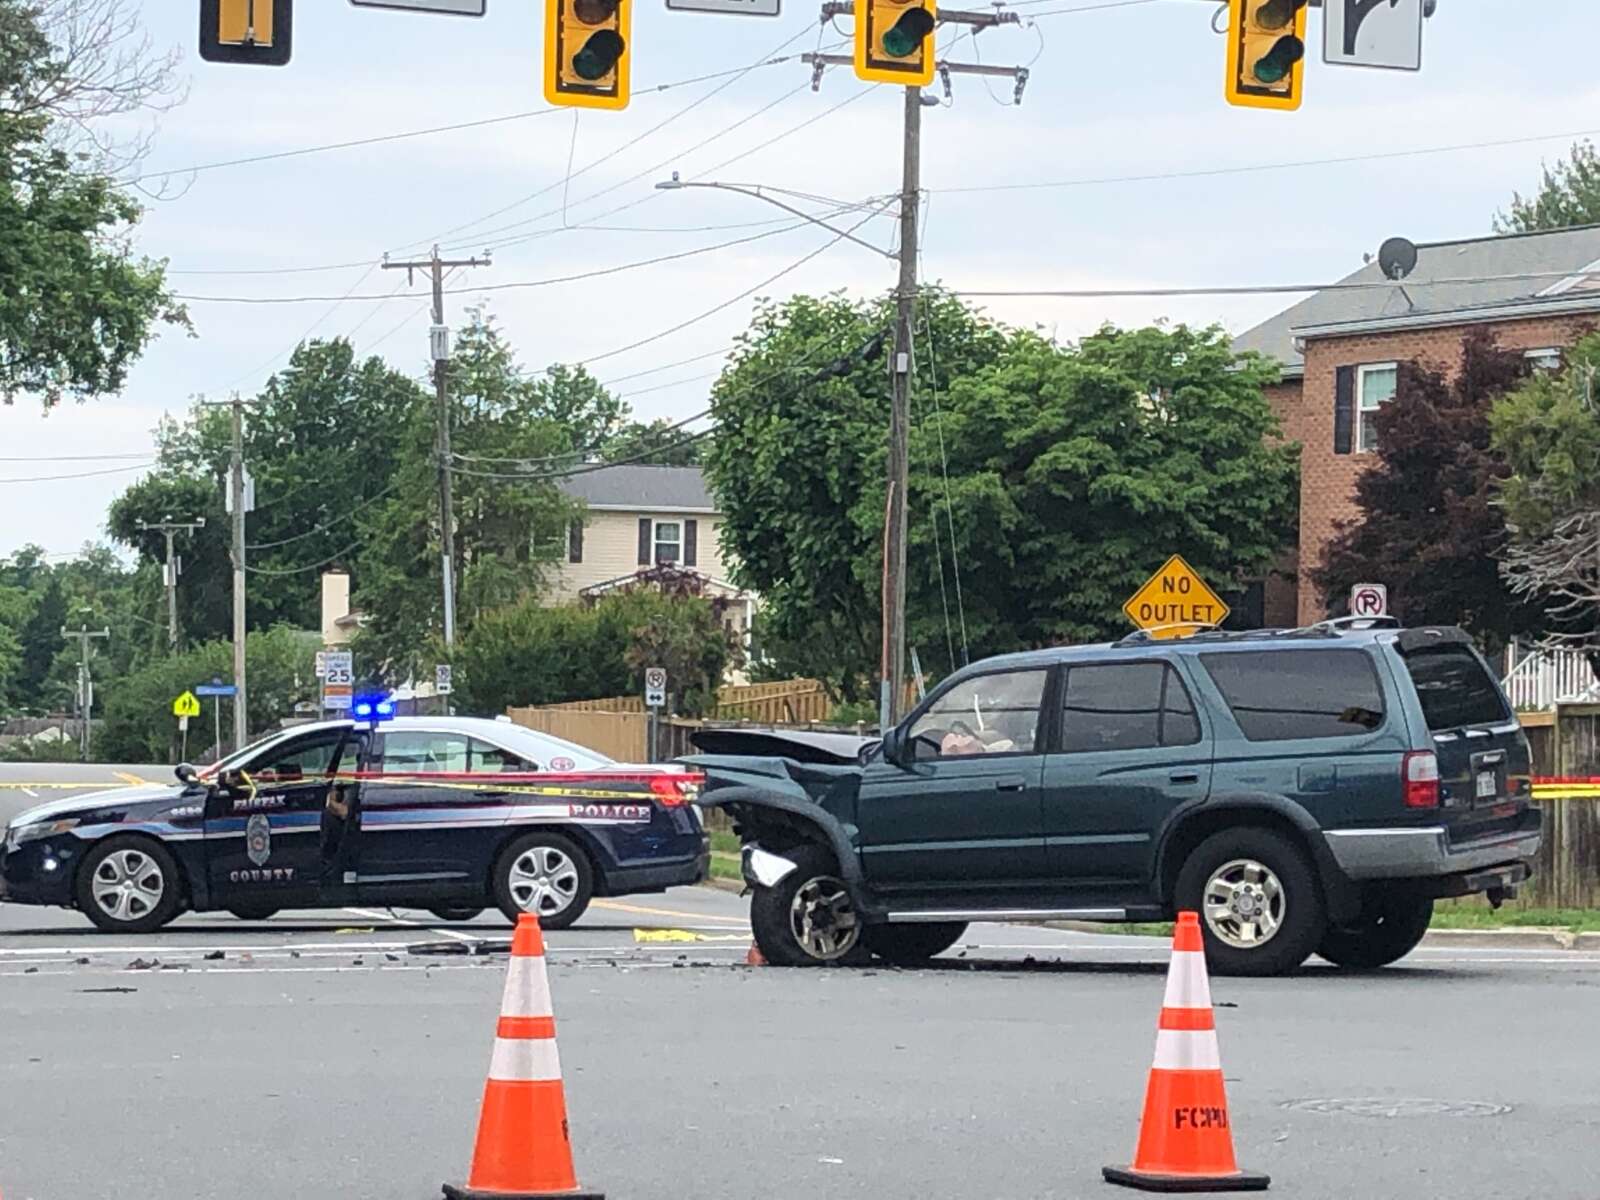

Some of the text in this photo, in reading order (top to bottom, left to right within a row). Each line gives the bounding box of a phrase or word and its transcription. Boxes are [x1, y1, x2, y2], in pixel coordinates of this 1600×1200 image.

[1163, 576, 1190, 594] NO
[1140, 603, 1214, 622] OUTLET
[328, 669, 350, 682] 25
[575, 805, 650, 818] POLICE
[230, 868, 294, 882] COUNTY
